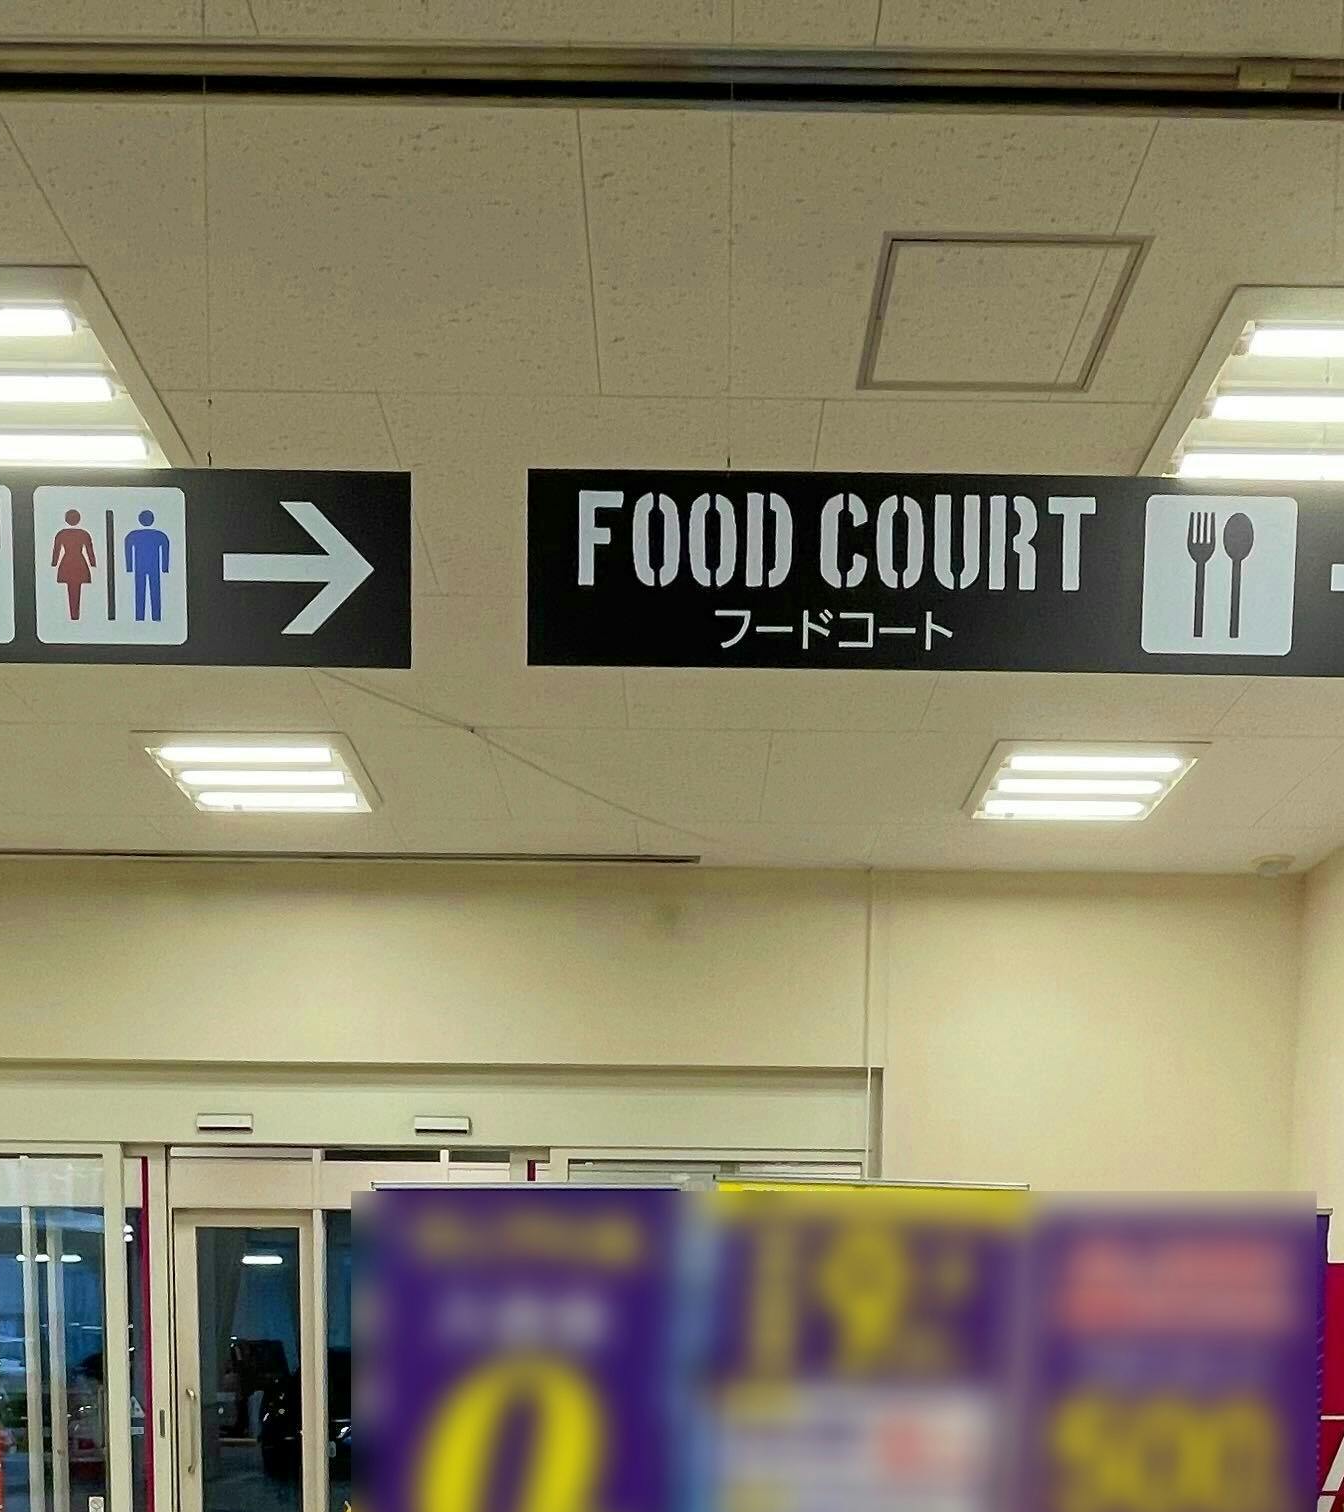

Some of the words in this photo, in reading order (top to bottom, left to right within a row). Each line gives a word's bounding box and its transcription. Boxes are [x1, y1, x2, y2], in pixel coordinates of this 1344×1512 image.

[577, 490, 793, 588] FOOD
[819, 492, 1097, 592] COURT
[714, 608, 953, 651] フードコート
